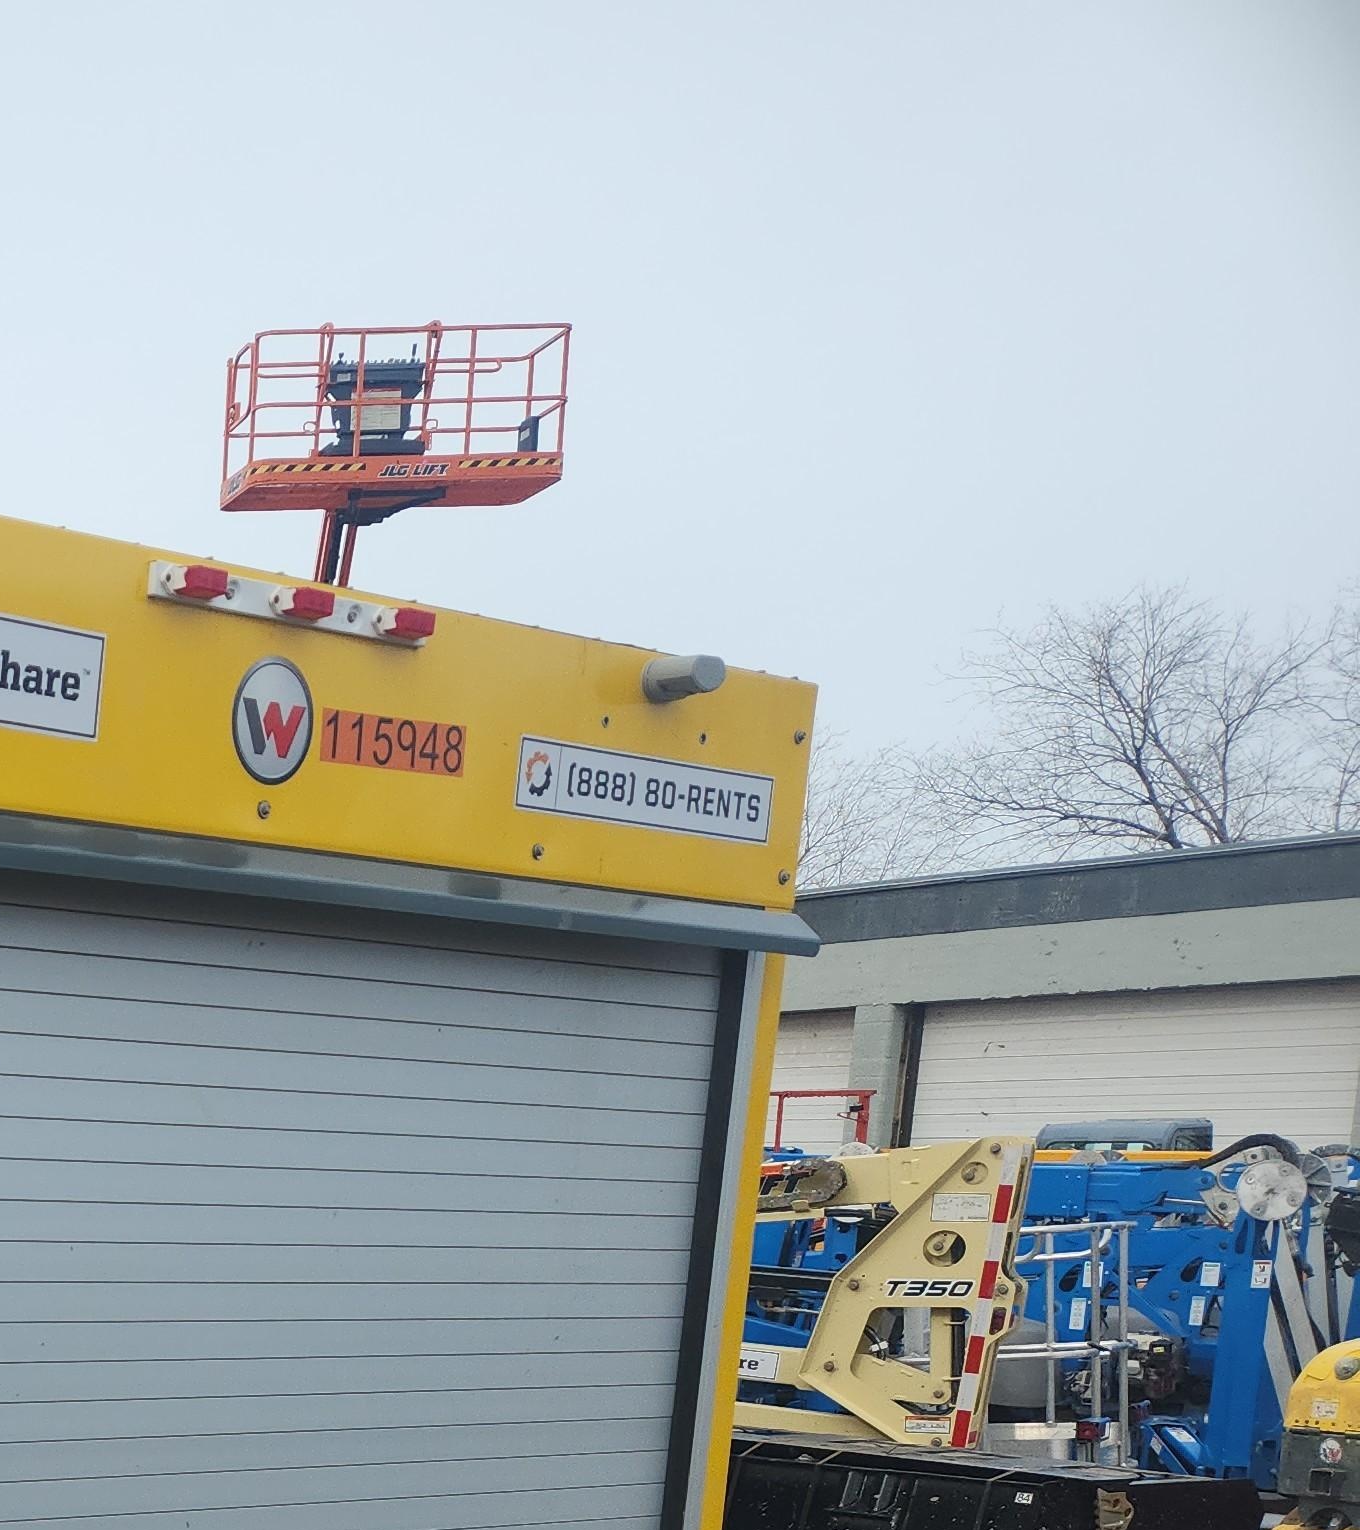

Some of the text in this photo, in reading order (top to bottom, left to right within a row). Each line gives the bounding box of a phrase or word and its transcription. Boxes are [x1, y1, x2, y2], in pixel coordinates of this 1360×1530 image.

[379, 463, 449, 477] JLG LIFT
[325, 711, 464, 773] 115948
[567, 762, 761, 822] (888) 80-RENTS
[886, 1280, 974, 1297] T350
